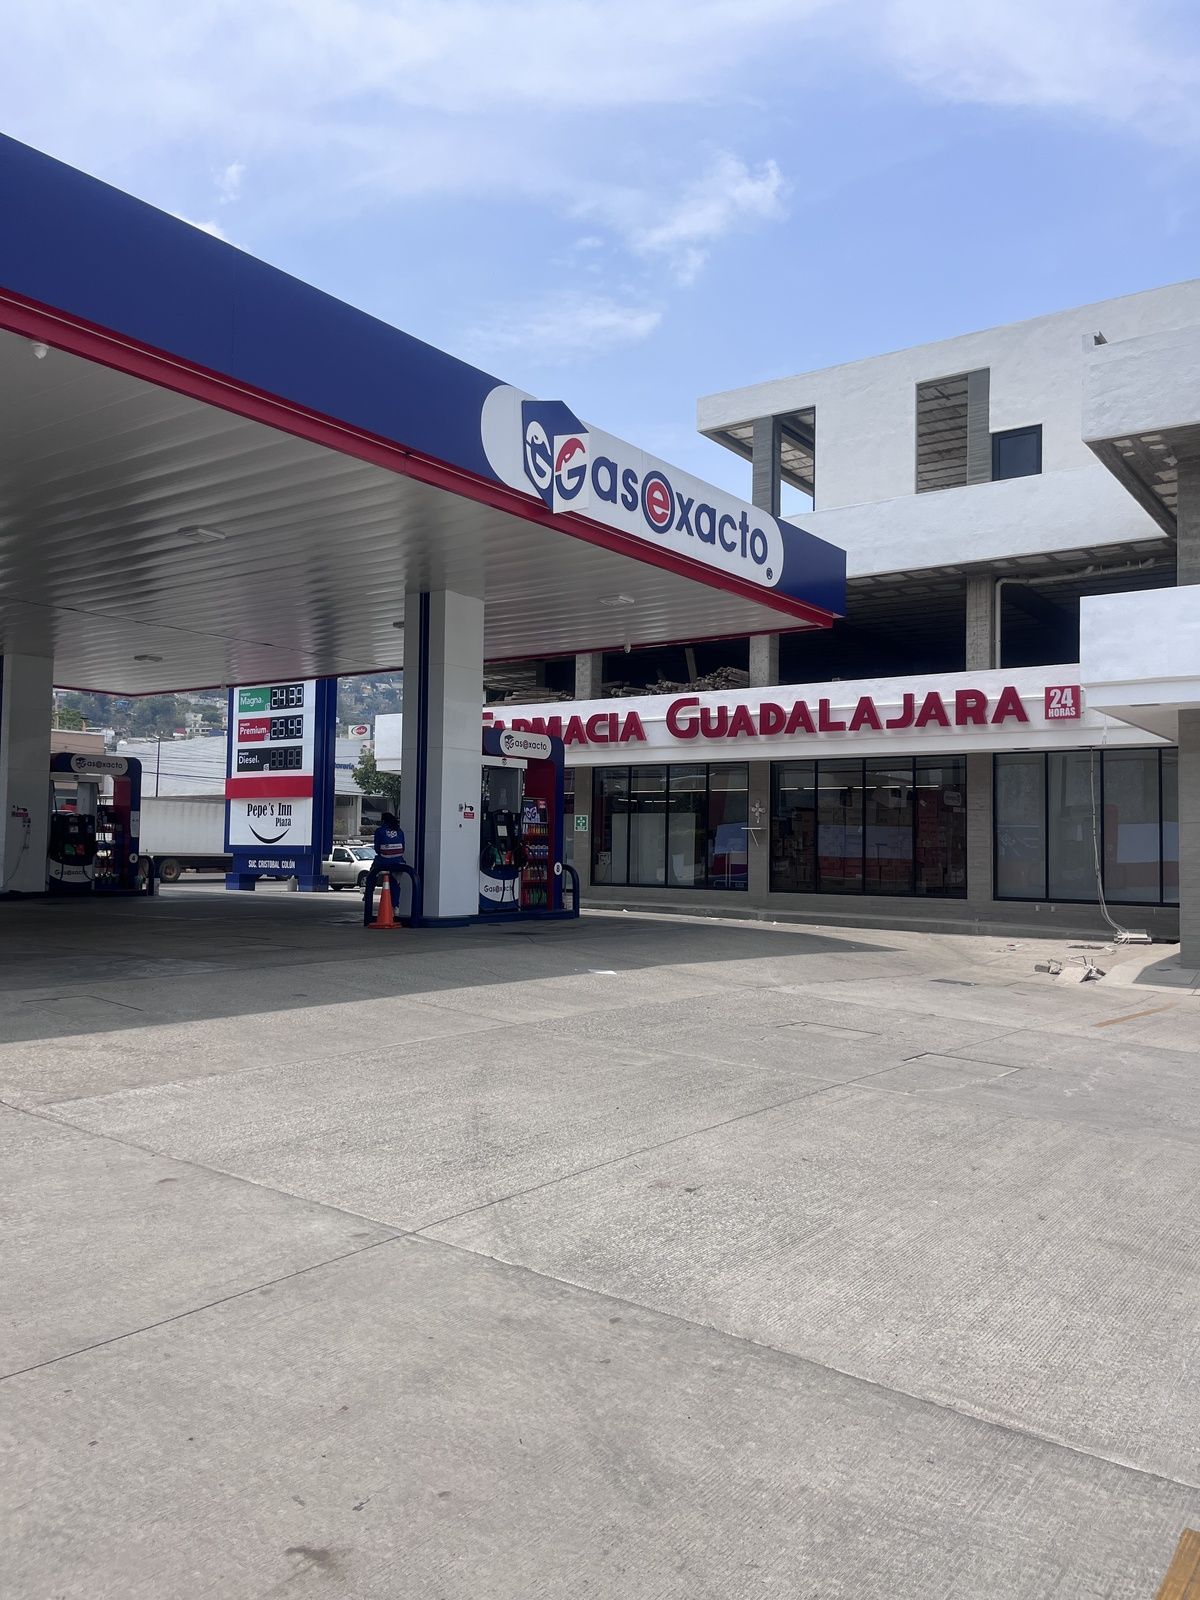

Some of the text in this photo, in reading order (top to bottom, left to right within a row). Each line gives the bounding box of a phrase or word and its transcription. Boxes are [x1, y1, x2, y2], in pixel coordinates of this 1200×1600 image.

[240, 696, 262, 706] Magna
[1050, 688, 1073, 708] 24
[1048, 707, 1076, 718] HORAS
[239, 726, 267, 735] Premium
[271, 718, 303, 738] 25.49
[238, 755, 258, 764] Diesel
[247, 803, 292, 818] Pepe's Inn
[275, 818, 292, 826] Plaza
